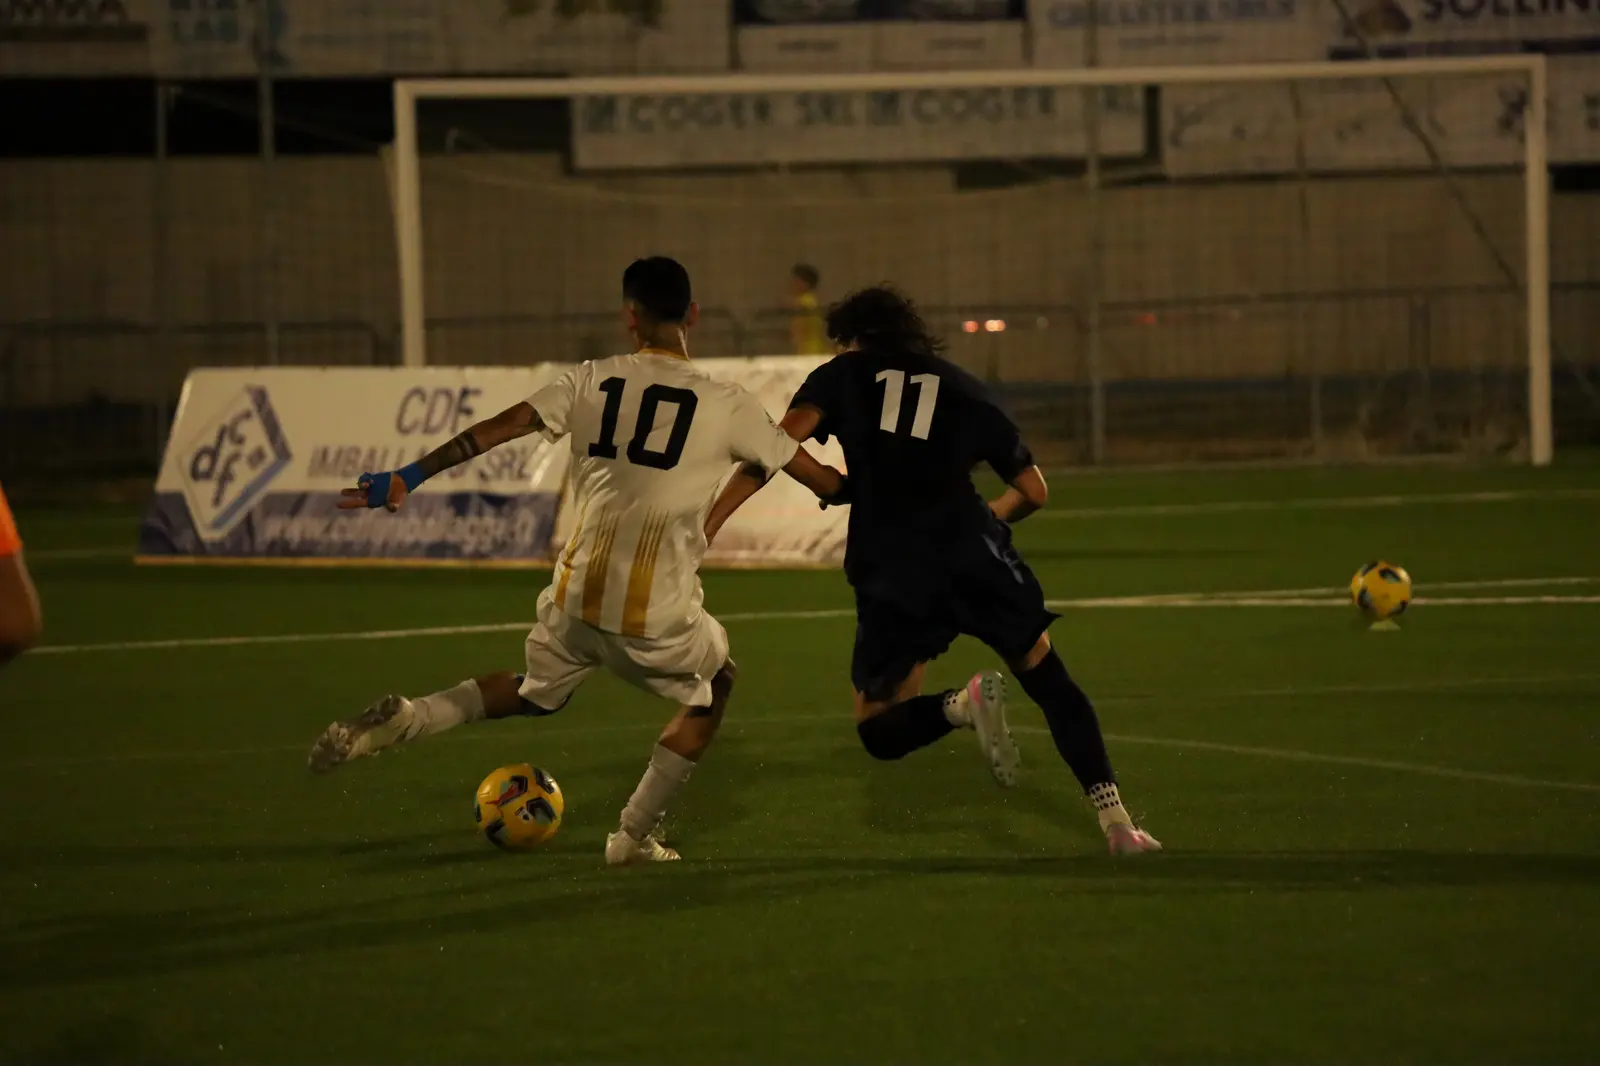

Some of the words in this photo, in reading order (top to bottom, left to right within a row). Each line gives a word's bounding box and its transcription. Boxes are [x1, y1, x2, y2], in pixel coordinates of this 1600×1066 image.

[395, 386, 482, 435] CDF
[588, 376, 698, 471] 10
[875, 368, 940, 440] 11
